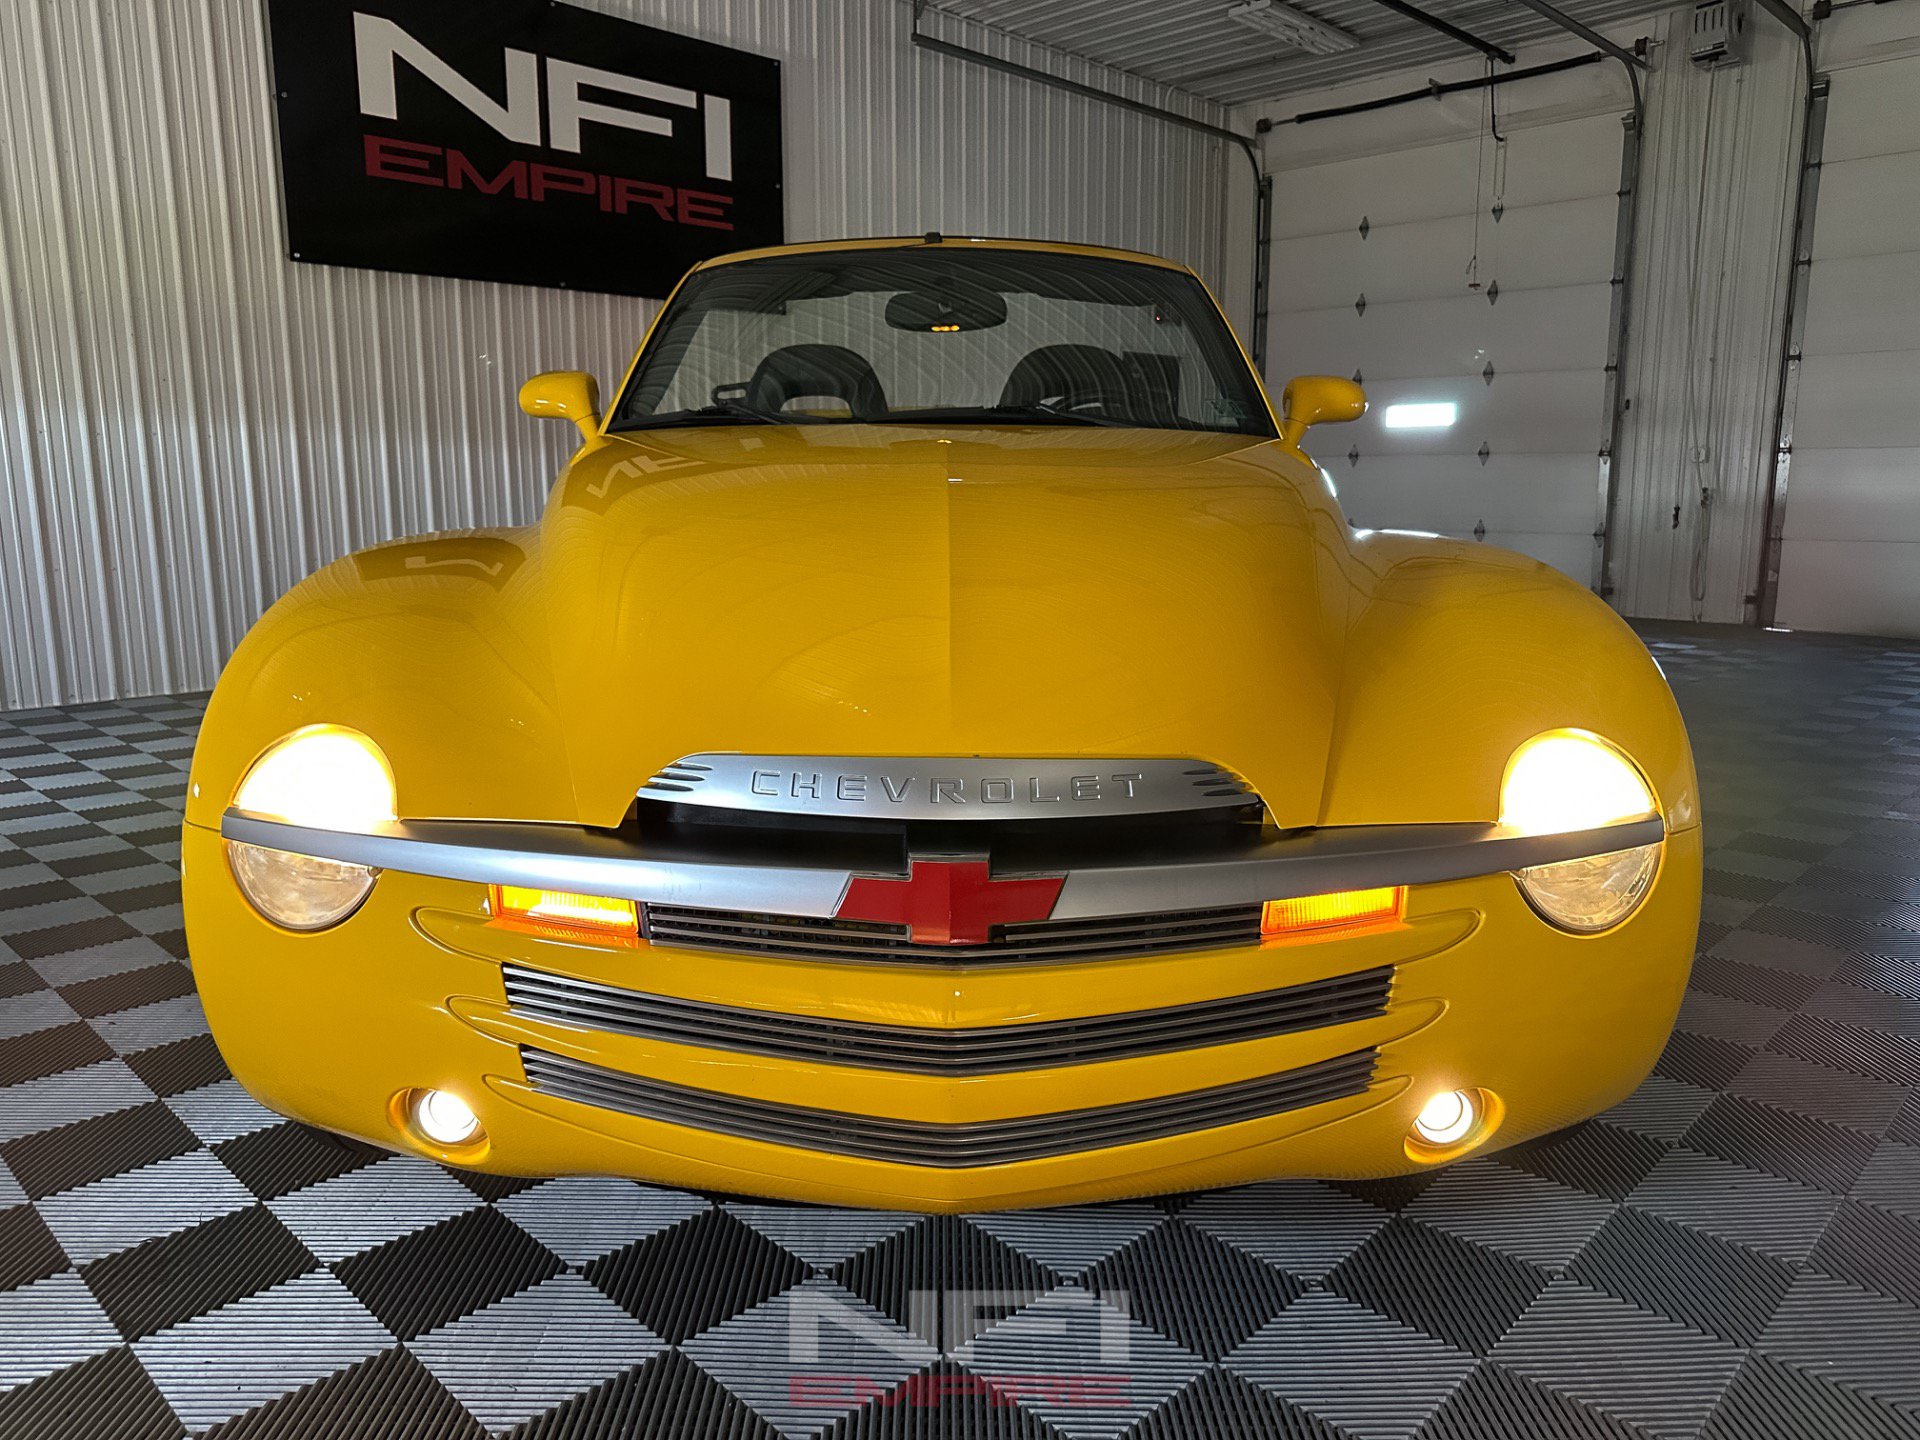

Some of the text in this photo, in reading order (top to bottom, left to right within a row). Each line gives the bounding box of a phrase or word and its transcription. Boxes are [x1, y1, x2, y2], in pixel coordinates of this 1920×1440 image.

[353, 11, 732, 182] NFI
[363, 134, 734, 231] EMPIRE
[750, 768, 1144, 804] CHEVROLET
